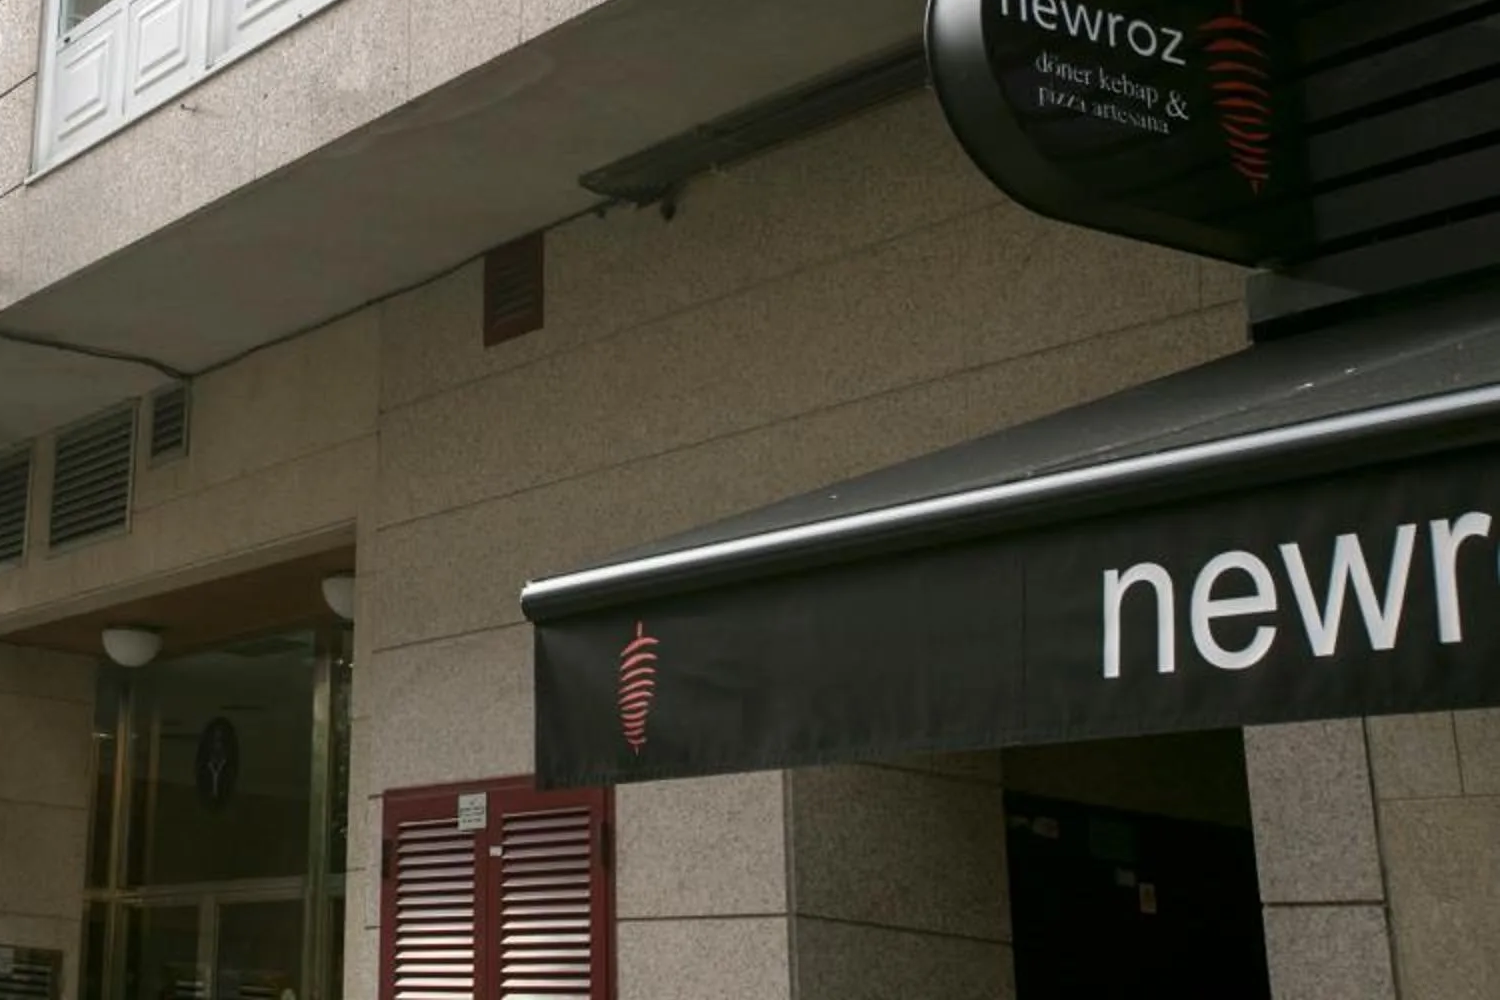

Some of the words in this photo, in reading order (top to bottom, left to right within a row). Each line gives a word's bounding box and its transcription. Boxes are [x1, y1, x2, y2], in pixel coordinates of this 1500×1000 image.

[1037, 85, 1087, 113] pizza
[1091, 101, 1172, 135] artesana
[1098, 65, 1160, 110] kebap
[1165, 88, 1190, 122] &
[1102, 510, 1500, 680] newr
